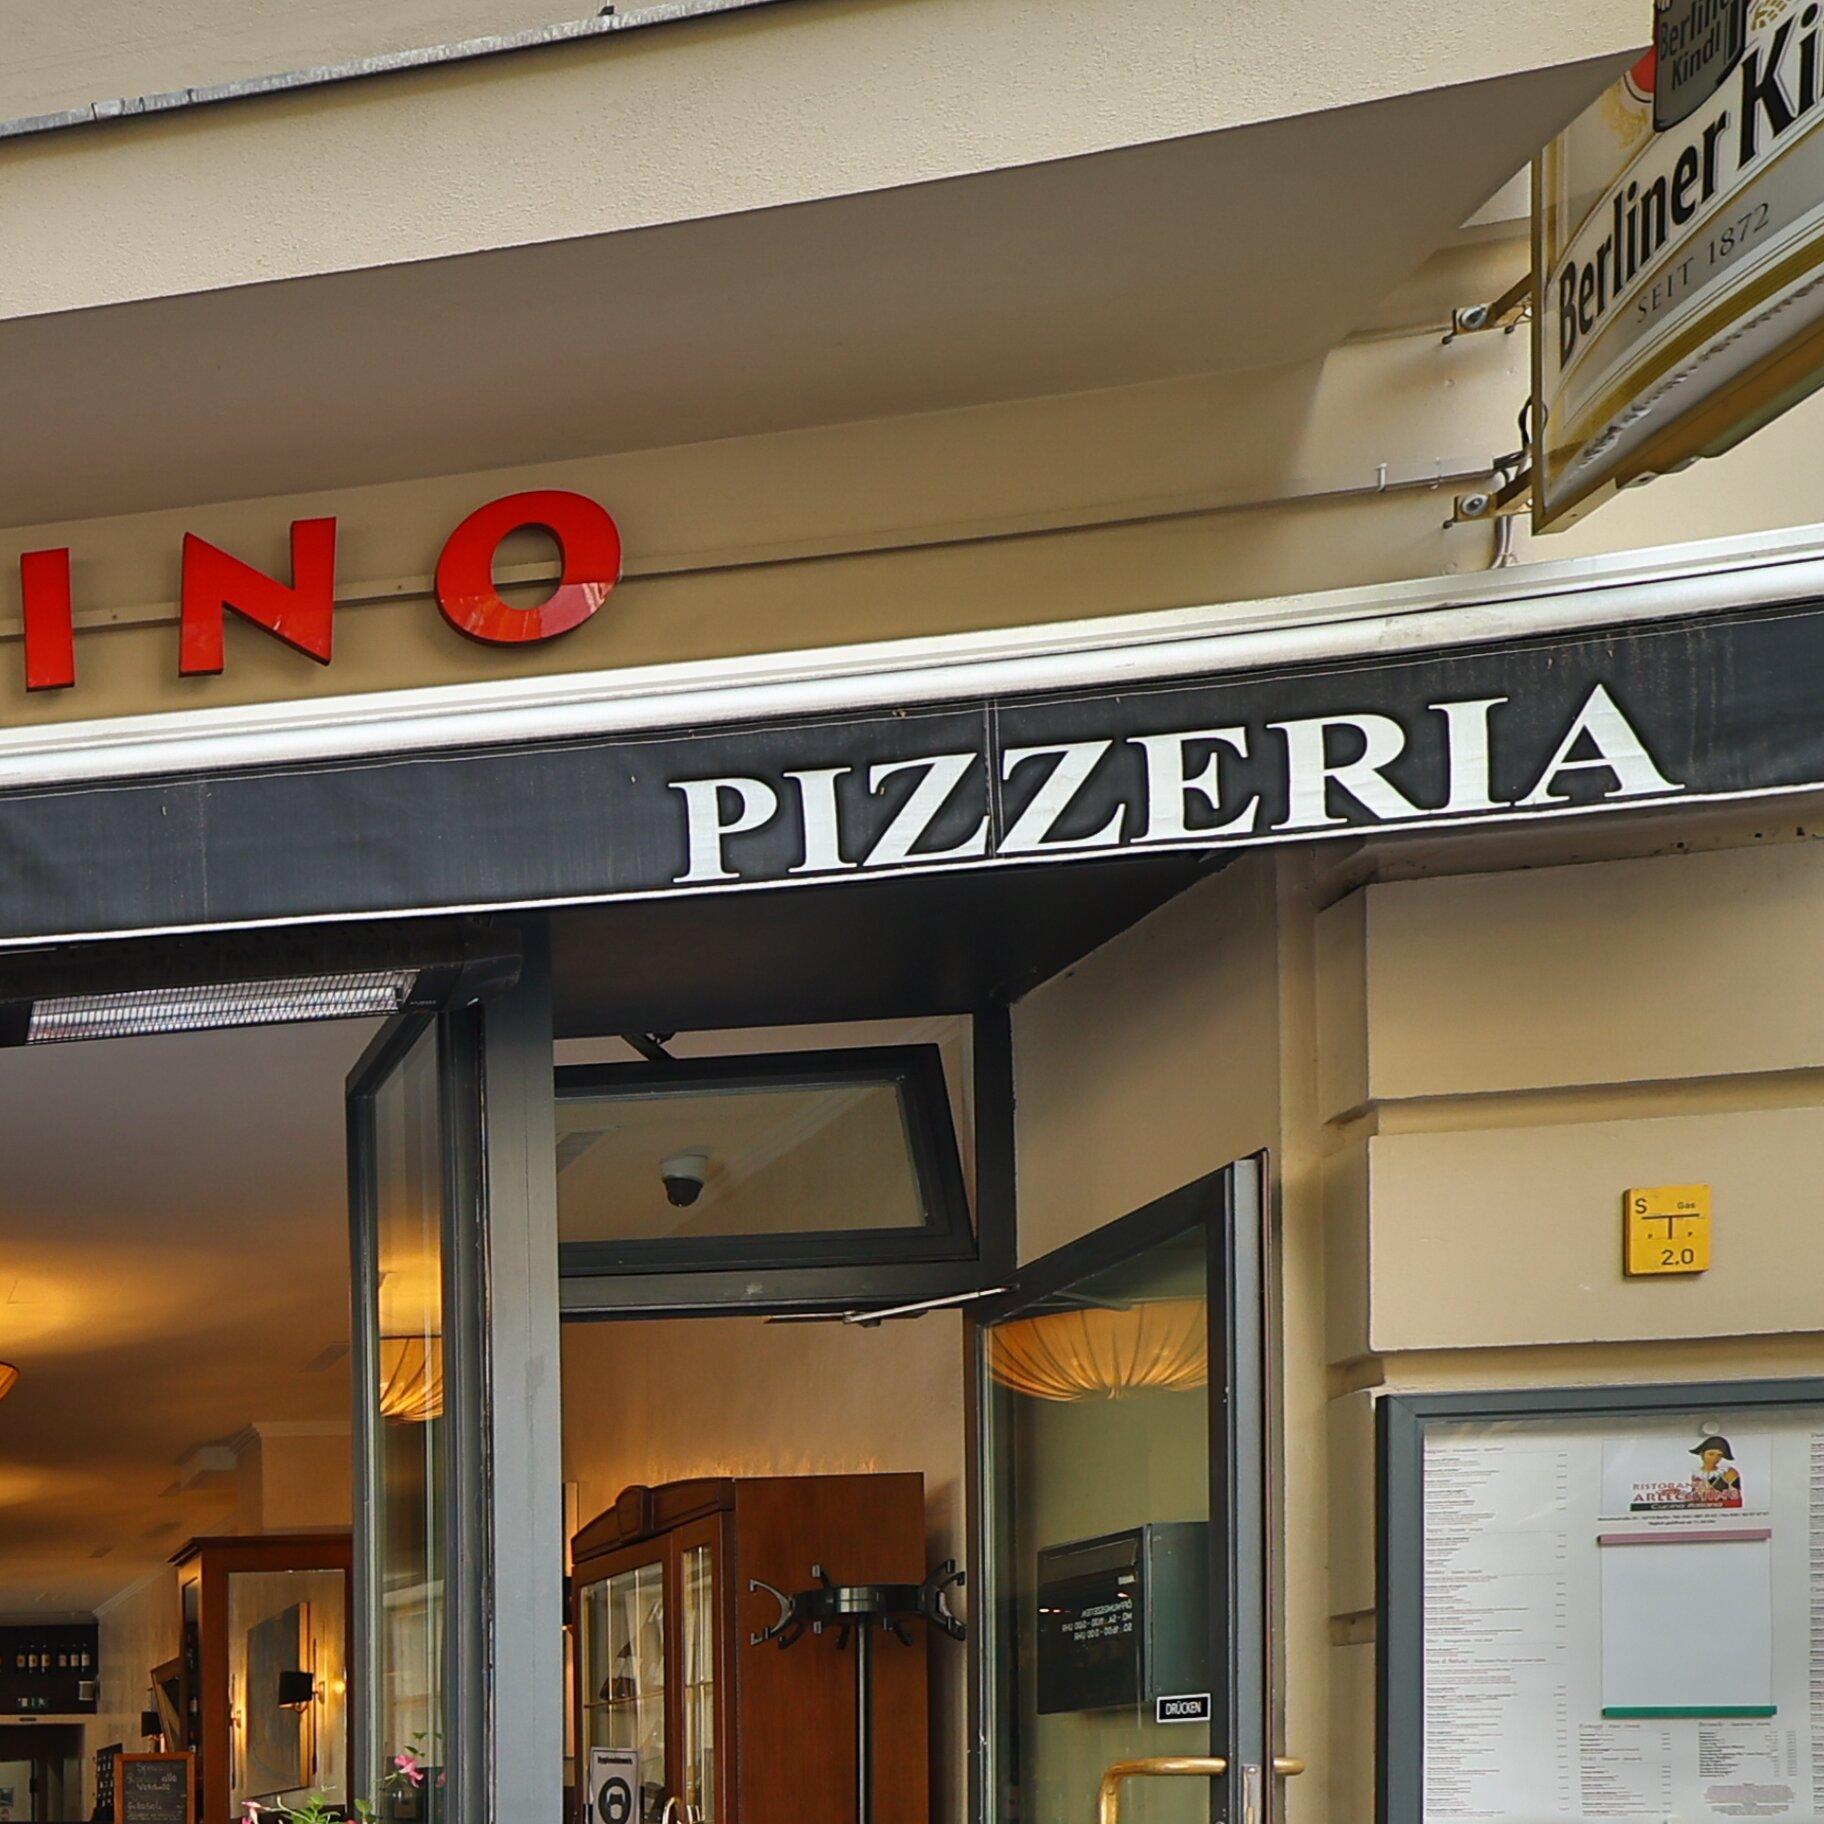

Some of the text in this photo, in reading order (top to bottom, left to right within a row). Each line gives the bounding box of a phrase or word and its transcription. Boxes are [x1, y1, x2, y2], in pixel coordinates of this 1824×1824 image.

[1672, 20, 1721, 90] Kindl
[1559, 2, 1824, 372] Berliner Ki
[1637, 202, 1770, 324] SEIT 1872
[667, 682, 1686, 884] PIZZERIA
[1634, 1197, 1696, 1214] S Gas
[1165, 1701, 1201, 1715] DRÜCKEN
